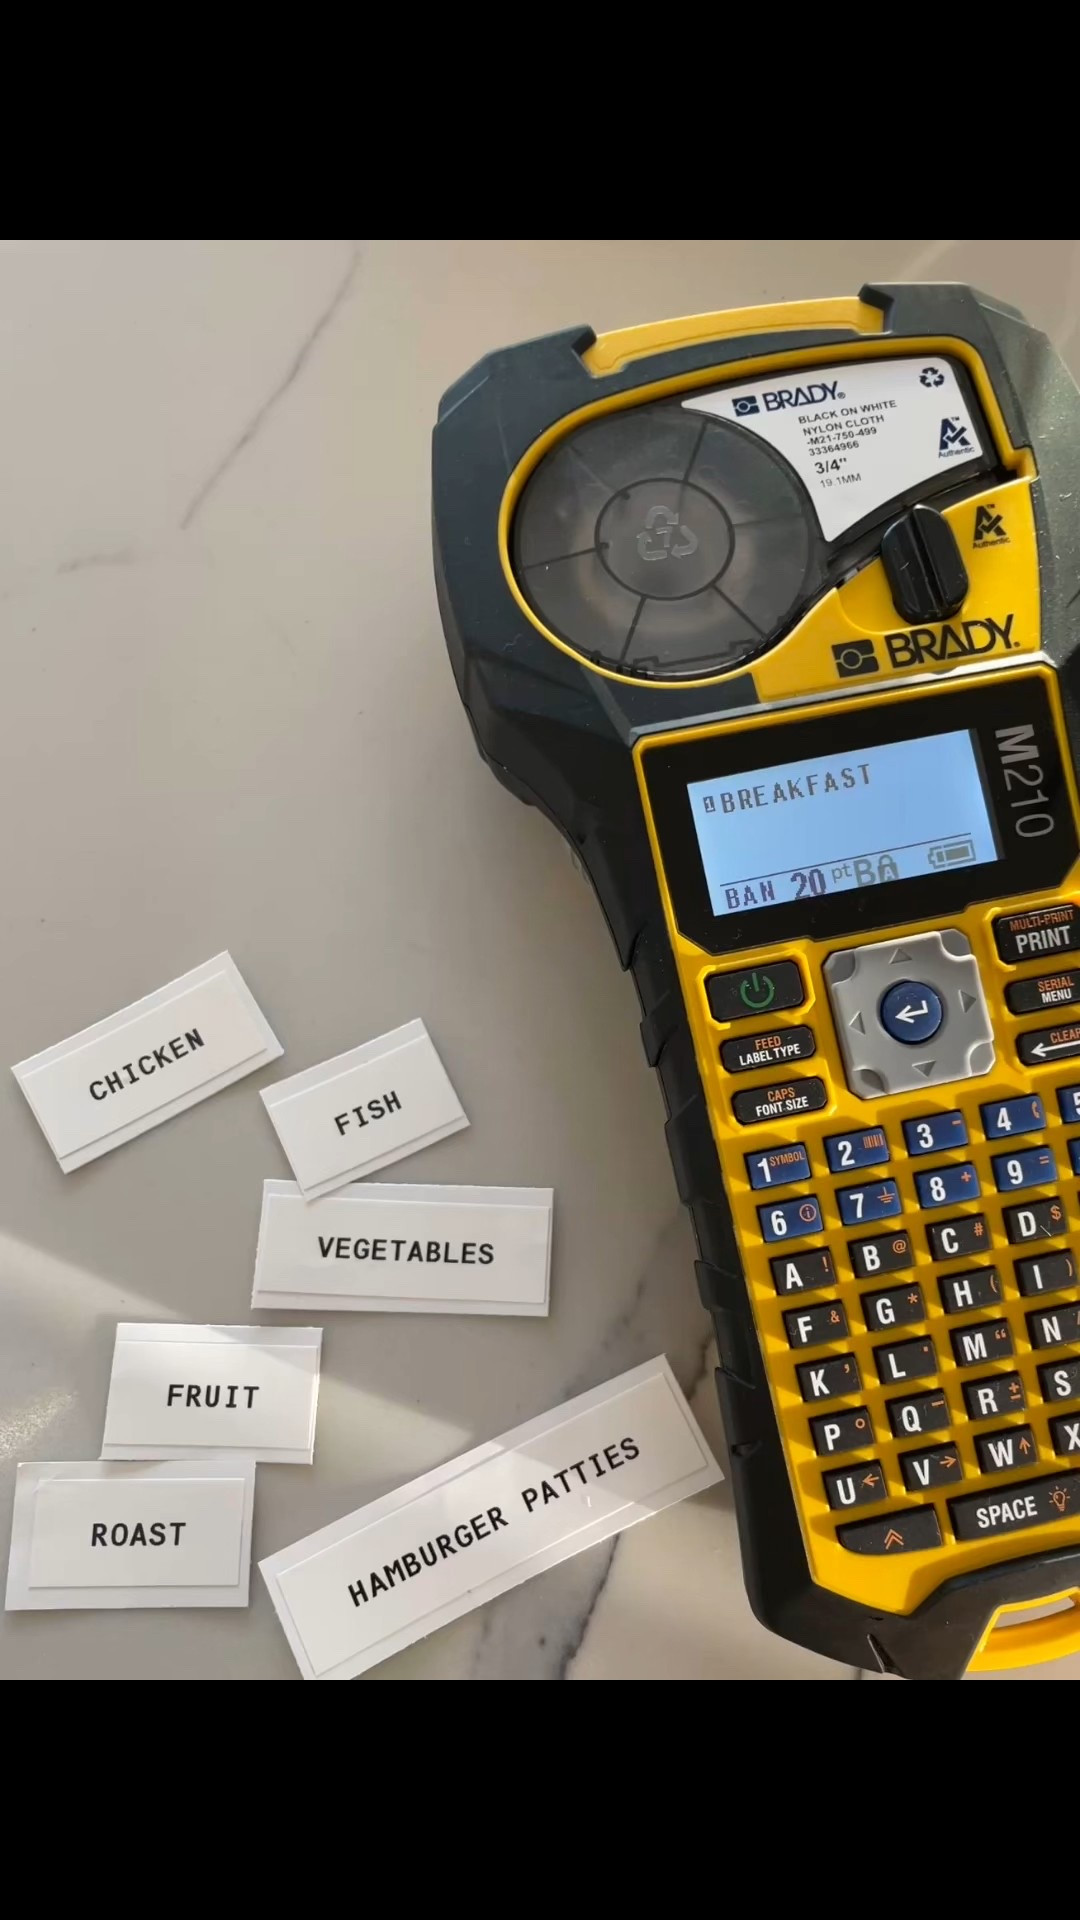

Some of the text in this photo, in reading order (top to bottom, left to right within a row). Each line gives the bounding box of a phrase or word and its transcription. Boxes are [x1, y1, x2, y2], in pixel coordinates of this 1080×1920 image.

[798, 400, 897, 424] BLACK ON WHITE
[803, 414, 885, 436] NYLON CLOTH
[938, 446, 975, 458] Authentic
[814, 457, 847, 474] 3/4"
[972, 537, 1010, 549] Authentic
[720, 763, 870, 814] BREAKFAST
[995, 724, 1054, 838] M210
[724, 880, 776, 910] BAN
[790, 868, 827, 900] 20
[1009, 909, 1073, 931] MULTI-PRINT
[1015, 925, 1070, 954] PRINT
[1038, 976, 1075, 992] SERIAL
[1041, 988, 1072, 1003] MENU
[739, 1043, 801, 1066] LABEL TYPE
[754, 1035, 782, 1050] FEED
[89, 1028, 204, 1101] CHICKEN
[755, 1096, 809, 1117] FONT SIZE
[767, 1087, 796, 1102] CAPS
[334, 1091, 402, 1136] FISH
[997, 1107, 1012, 1131] 4
[917, 1123, 934, 1149] 3
[757, 1151, 805, 1182] 1 SYMBOL
[838, 1141, 855, 1167] 2
[1007, 1160, 1023, 1185] 9
[929, 1176, 946, 1201] 8
[849, 1193, 864, 1218] 7
[770, 1210, 788, 1236] 6
[1017, 1211, 1037, 1237] D
[318, 1236, 494, 1265] VEGETABLES
[941, 1228, 959, 1253] C
[862, 1245, 881, 1271] B
[786, 1263, 804, 1290] A
[1032, 1264, 1044, 1290] I
[953, 1280, 974, 1307] H
[876, 1298, 896, 1325] G
[797, 1316, 813, 1343] F
[1041, 1316, 1062, 1343] N
[962, 1333, 988, 1361] M
[888, 1353, 906, 1379] L
[809, 1369, 830, 1397] K
[1053, 1369, 1072, 1397] S
[167, 1384, 260, 1409] FRUIT
[977, 1388, 998, 1415] R
[901, 1405, 922, 1433] Q
[823, 1423, 841, 1451] P
[1063, 1422, 1080, 1451] X
[988, 1438, 1014, 1468] W
[912, 1458, 930, 1486] V
[836, 1477, 857, 1505] U
[347, 1437, 640, 1607] HAMBURGER PATTIES
[975, 1495, 1038, 1529] SPACE
[91, 1522, 186, 1547] ROAST
